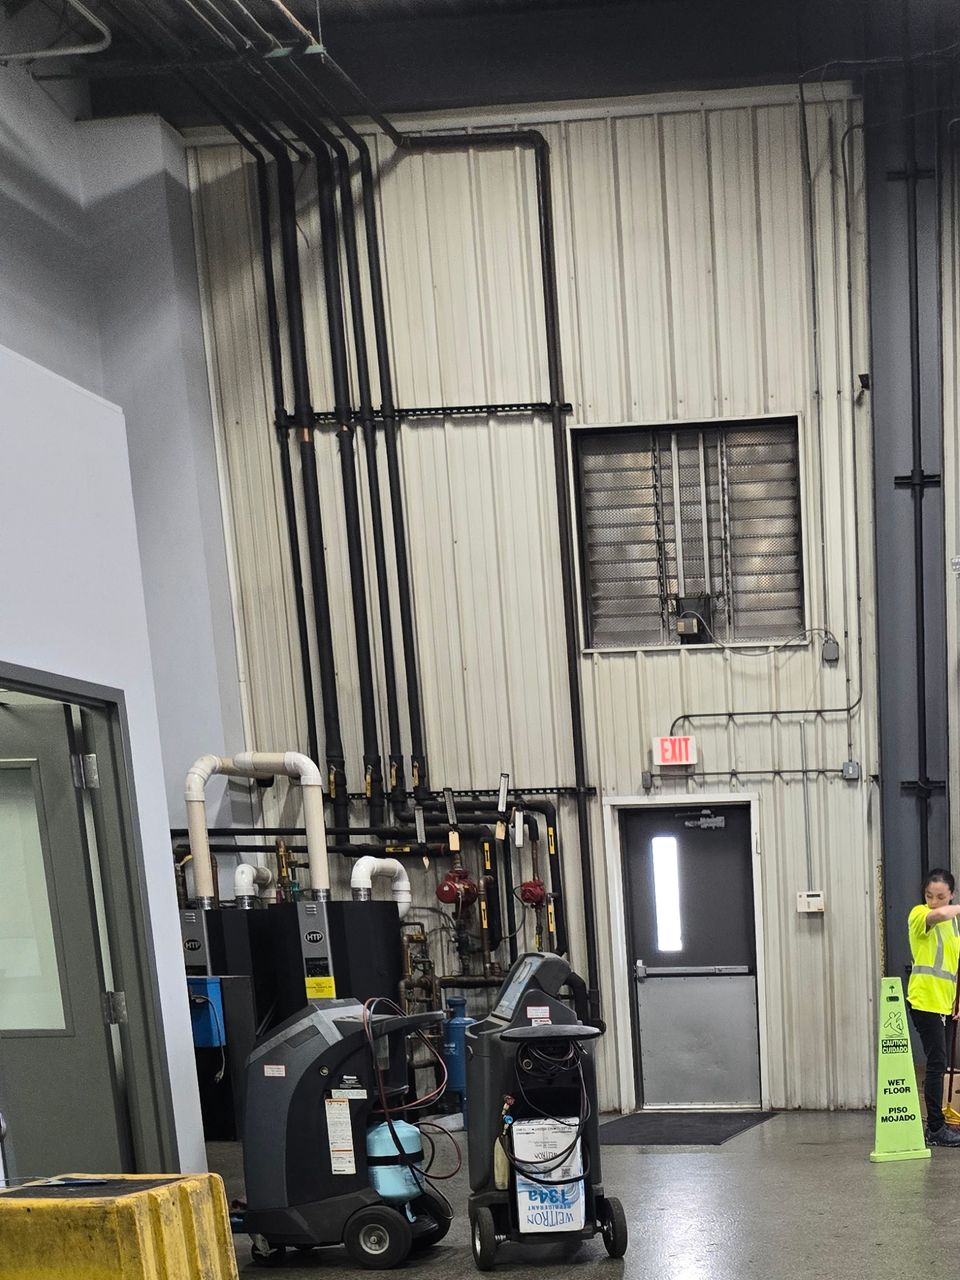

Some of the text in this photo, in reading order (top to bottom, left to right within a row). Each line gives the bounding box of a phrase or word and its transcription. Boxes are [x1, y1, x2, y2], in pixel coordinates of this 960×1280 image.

[660, 737, 690, 763] EXIT
[306, 933, 322, 942] HTP
[185, 941, 200, 949] HTP
[884, 1086, 911, 1095] FLOOR
[888, 1106, 908, 1114] PISO
[881, 1114, 916, 1123] MOJADO
[528, 1189, 568, 1204] 134a
[527, 1211, 574, 1227] WEITRON
